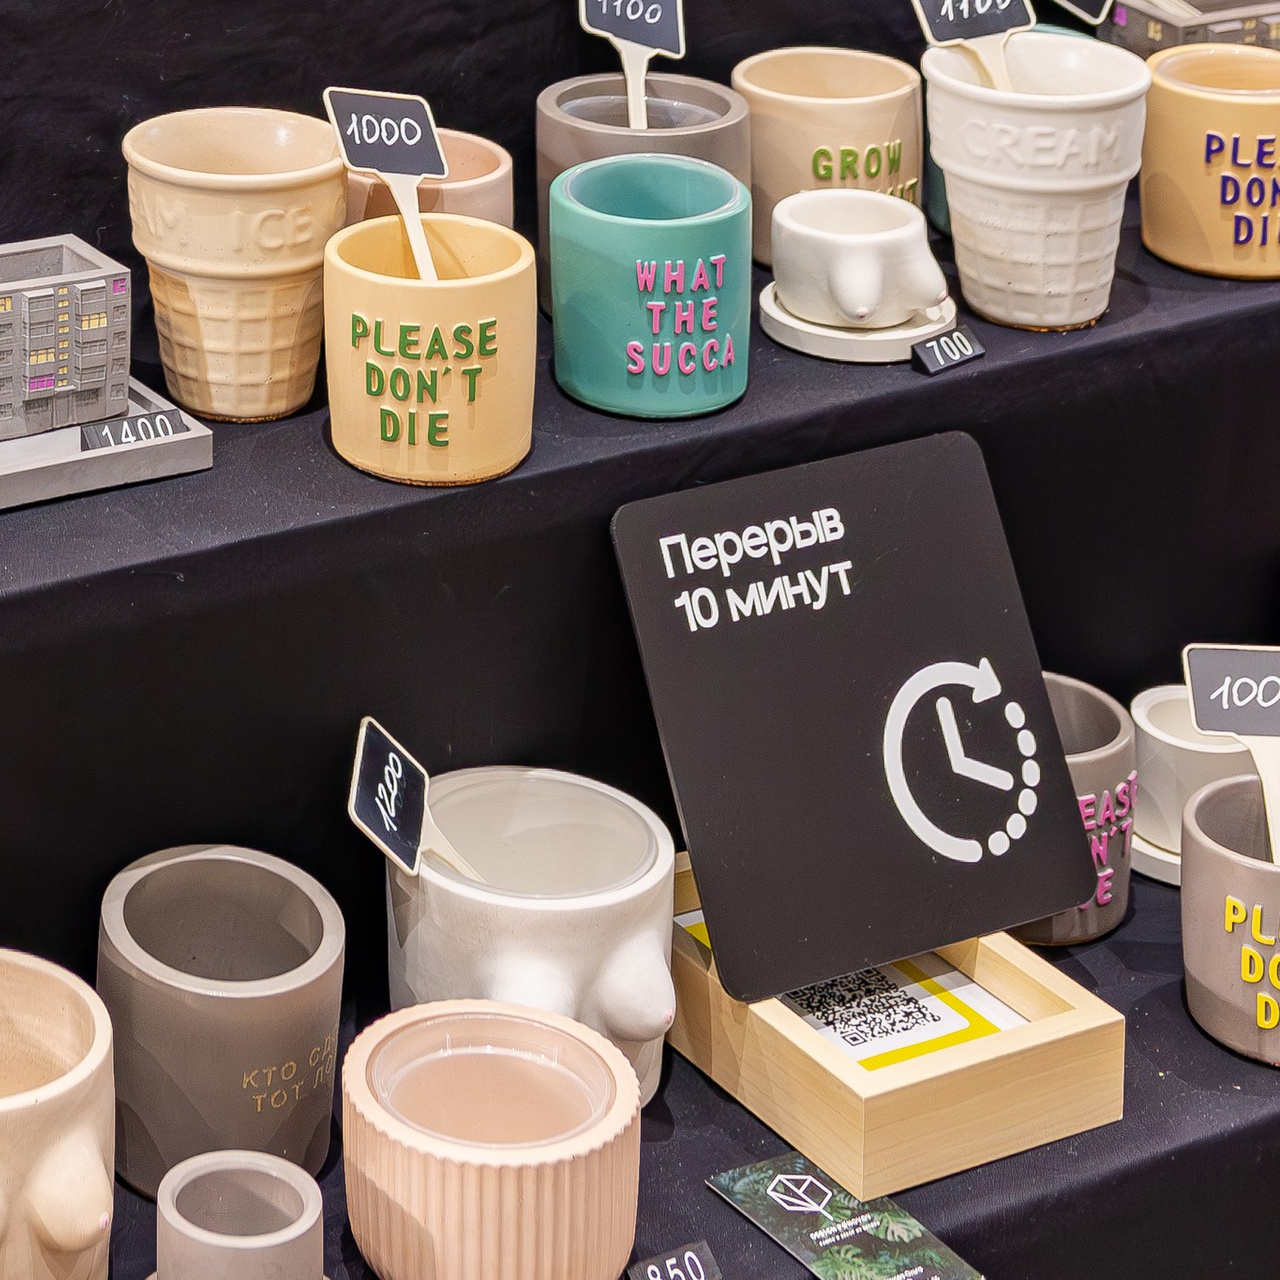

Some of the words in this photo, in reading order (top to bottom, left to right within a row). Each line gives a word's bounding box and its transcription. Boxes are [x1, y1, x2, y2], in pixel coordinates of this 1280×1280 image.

[346, 111, 422, 146] 1000
[812, 138, 903, 181] GROW
[1233, 211, 1280, 247] DI
[634, 253, 728, 296] WHAT
[350, 311, 500, 362] PLEASE
[646, 296, 719, 336] THE
[625, 333, 736, 376] SUCCA
[925, 331, 975, 368] 700
[364, 360, 482, 406] DON'T
[100, 413, 175, 448] 1400
[379, 406, 451, 448] DIE
[658, 506, 846, 581] Перерыв
[673, 587, 719, 633] 10
[724, 559, 856, 622] минут
[374, 751, 403, 832] 1200
[242, 1061, 297, 1089] КТО
[252, 1080, 304, 1113] ТОТ
